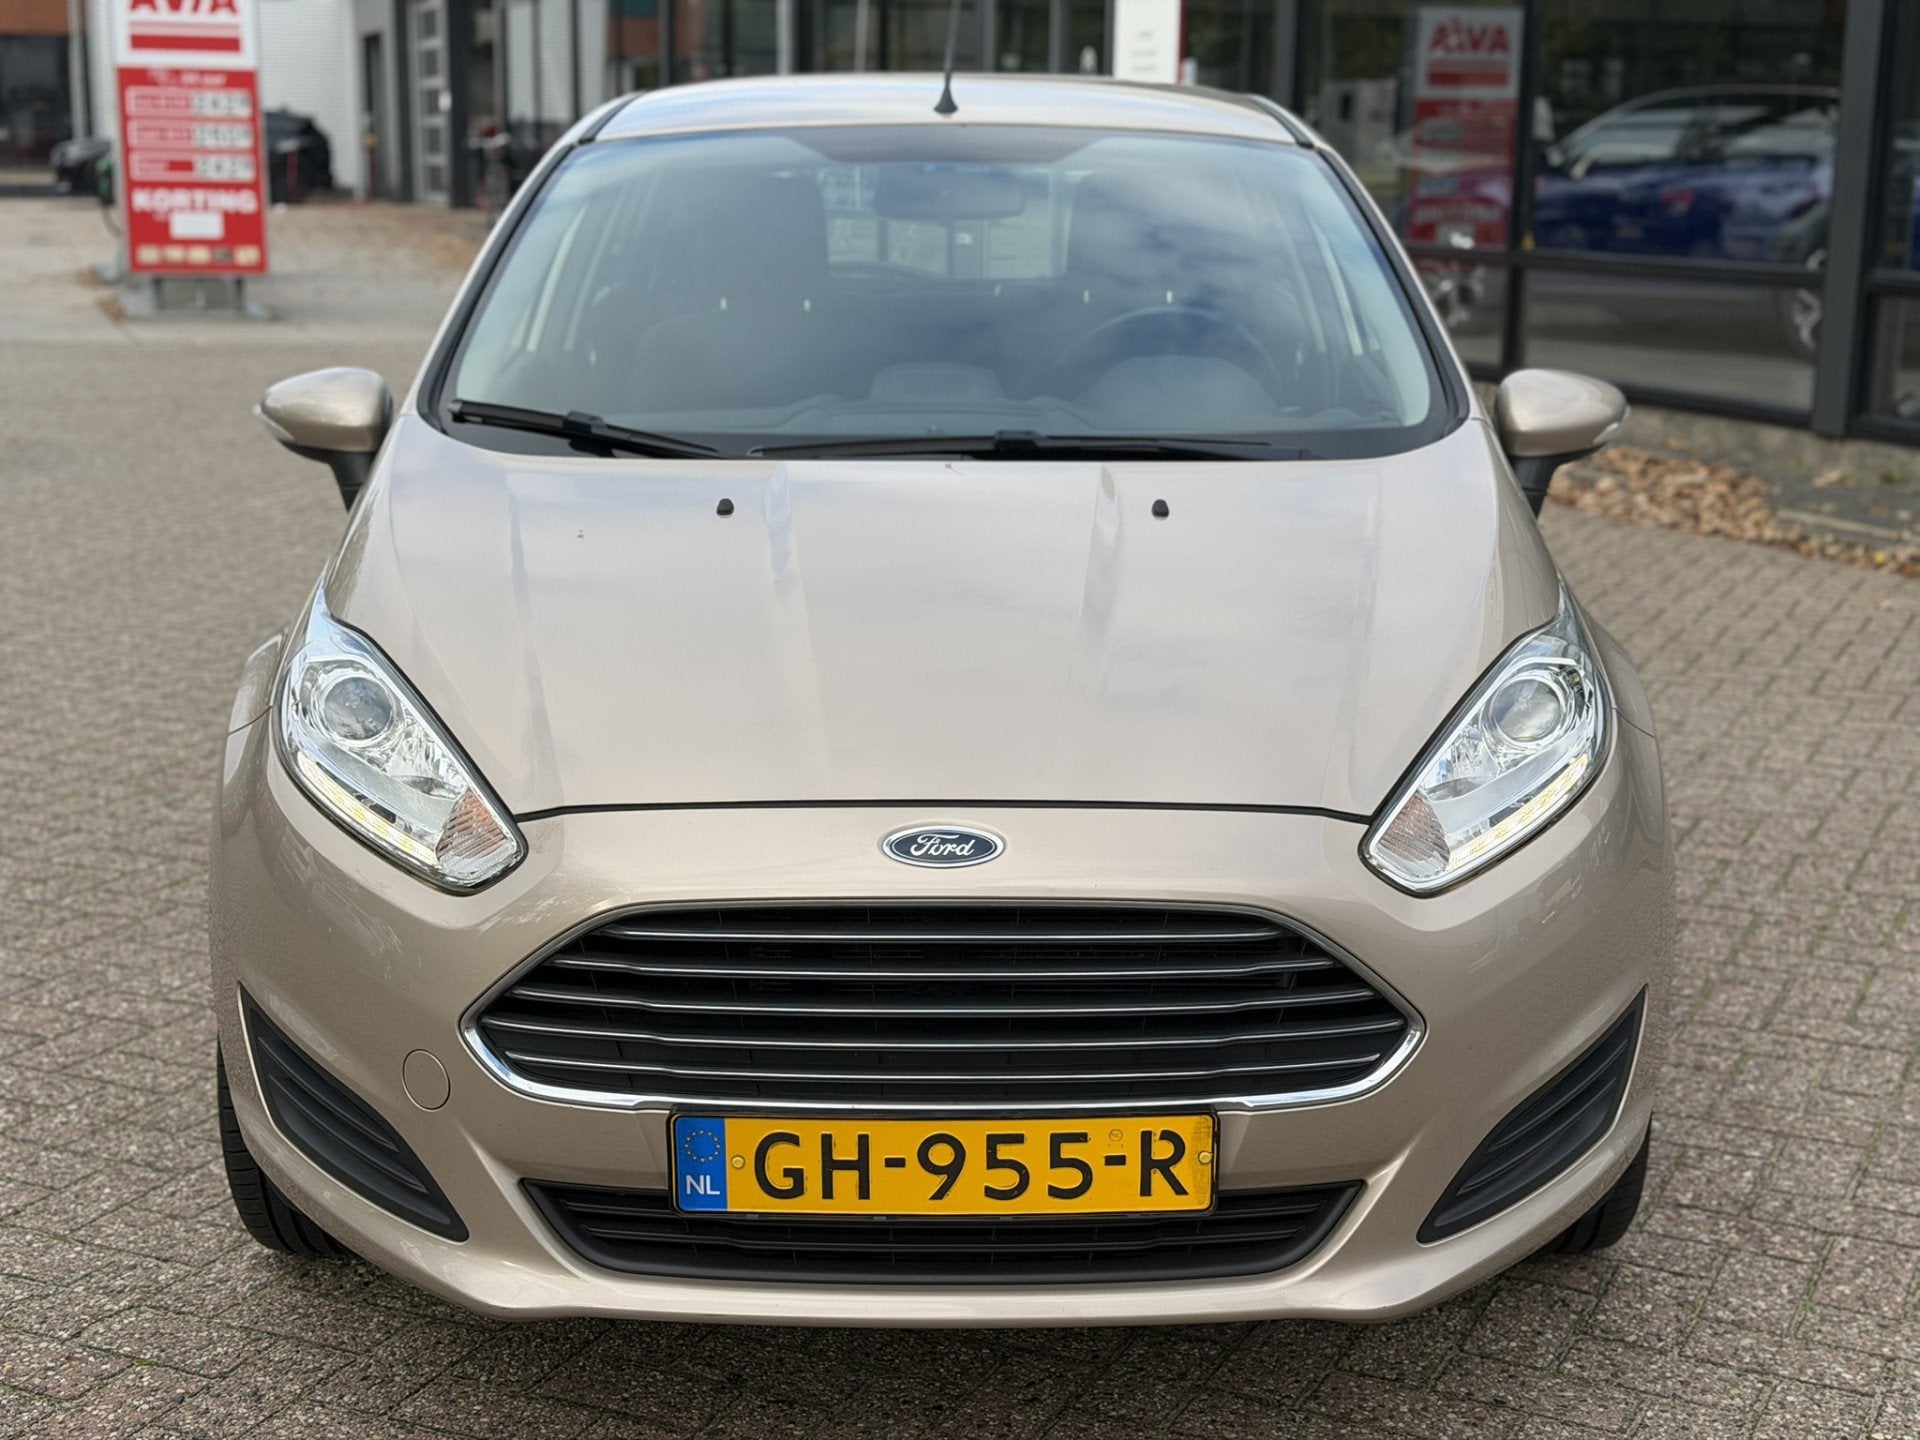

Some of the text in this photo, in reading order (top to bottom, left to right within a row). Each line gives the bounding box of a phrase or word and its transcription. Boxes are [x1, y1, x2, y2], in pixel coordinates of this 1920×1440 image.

[910, 833, 976, 856] Ford
[753, 1129, 1190, 1201] GH-955-R
[685, 1174, 721, 1196] NL
